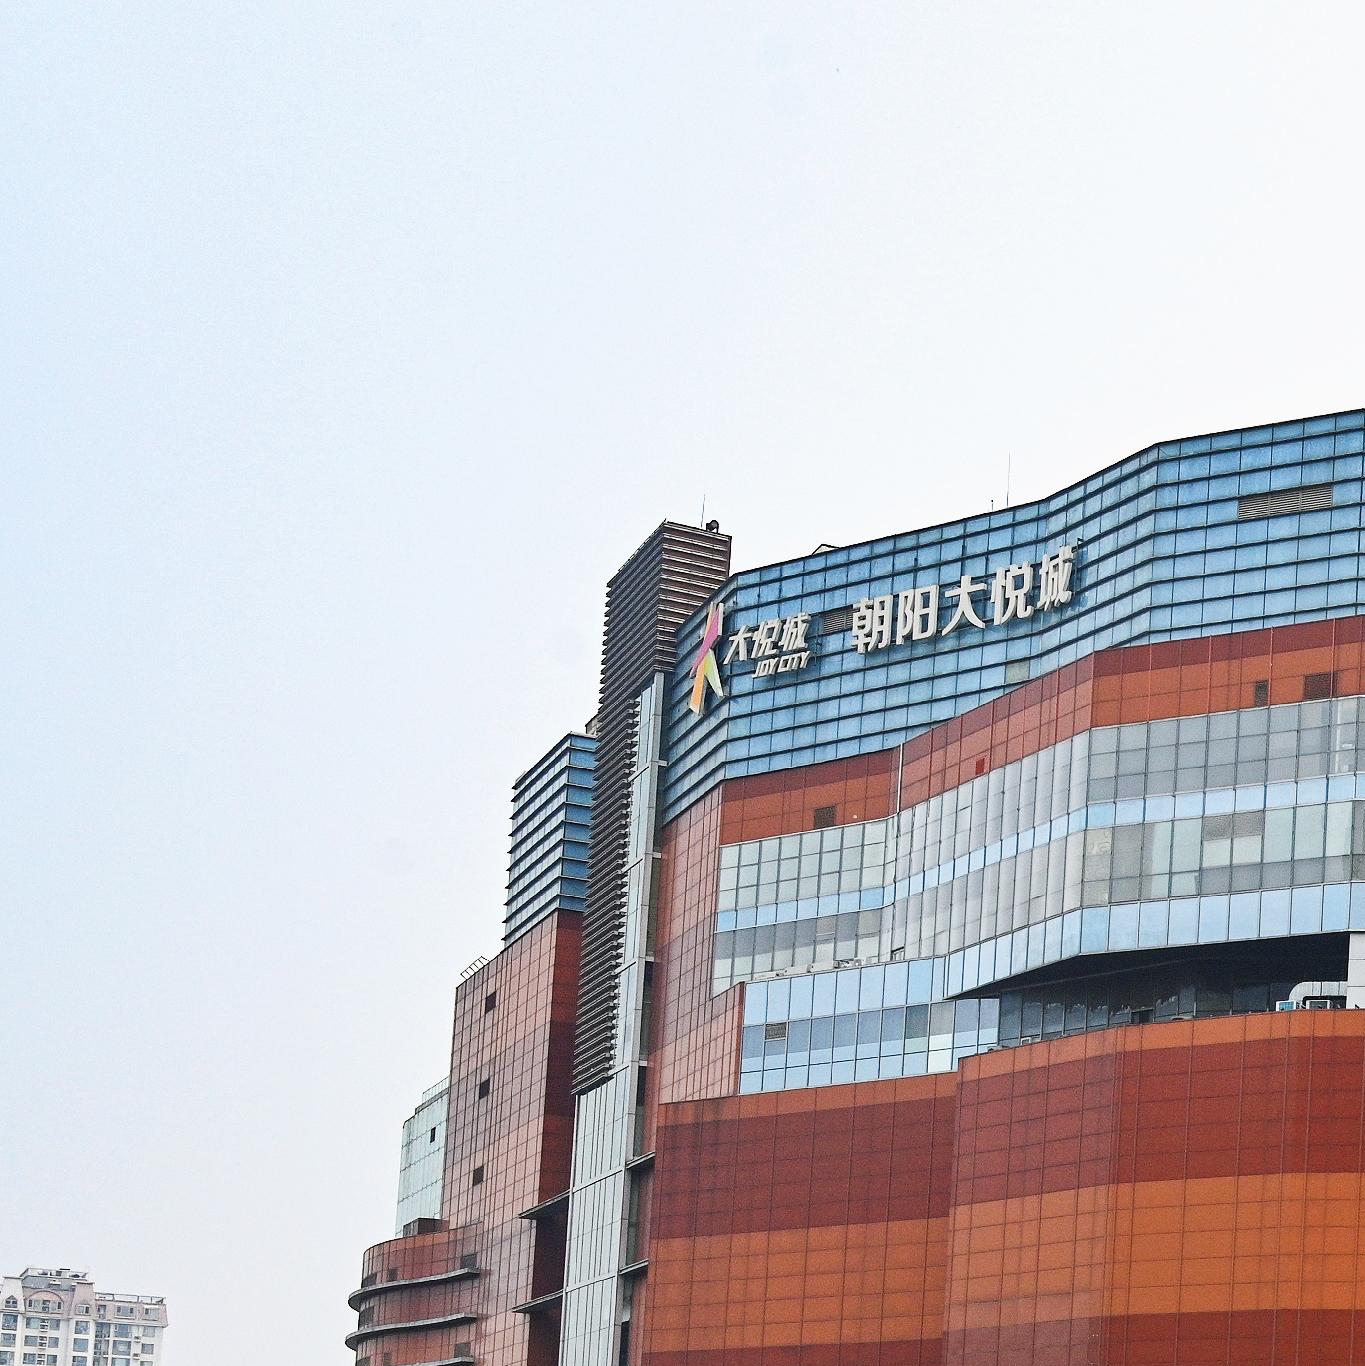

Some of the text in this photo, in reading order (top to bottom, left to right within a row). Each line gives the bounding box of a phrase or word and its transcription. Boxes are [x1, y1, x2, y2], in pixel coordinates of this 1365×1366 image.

[723, 611, 811, 665] 大悦城
[851, 546, 1077, 654] 朝阳大悦城
